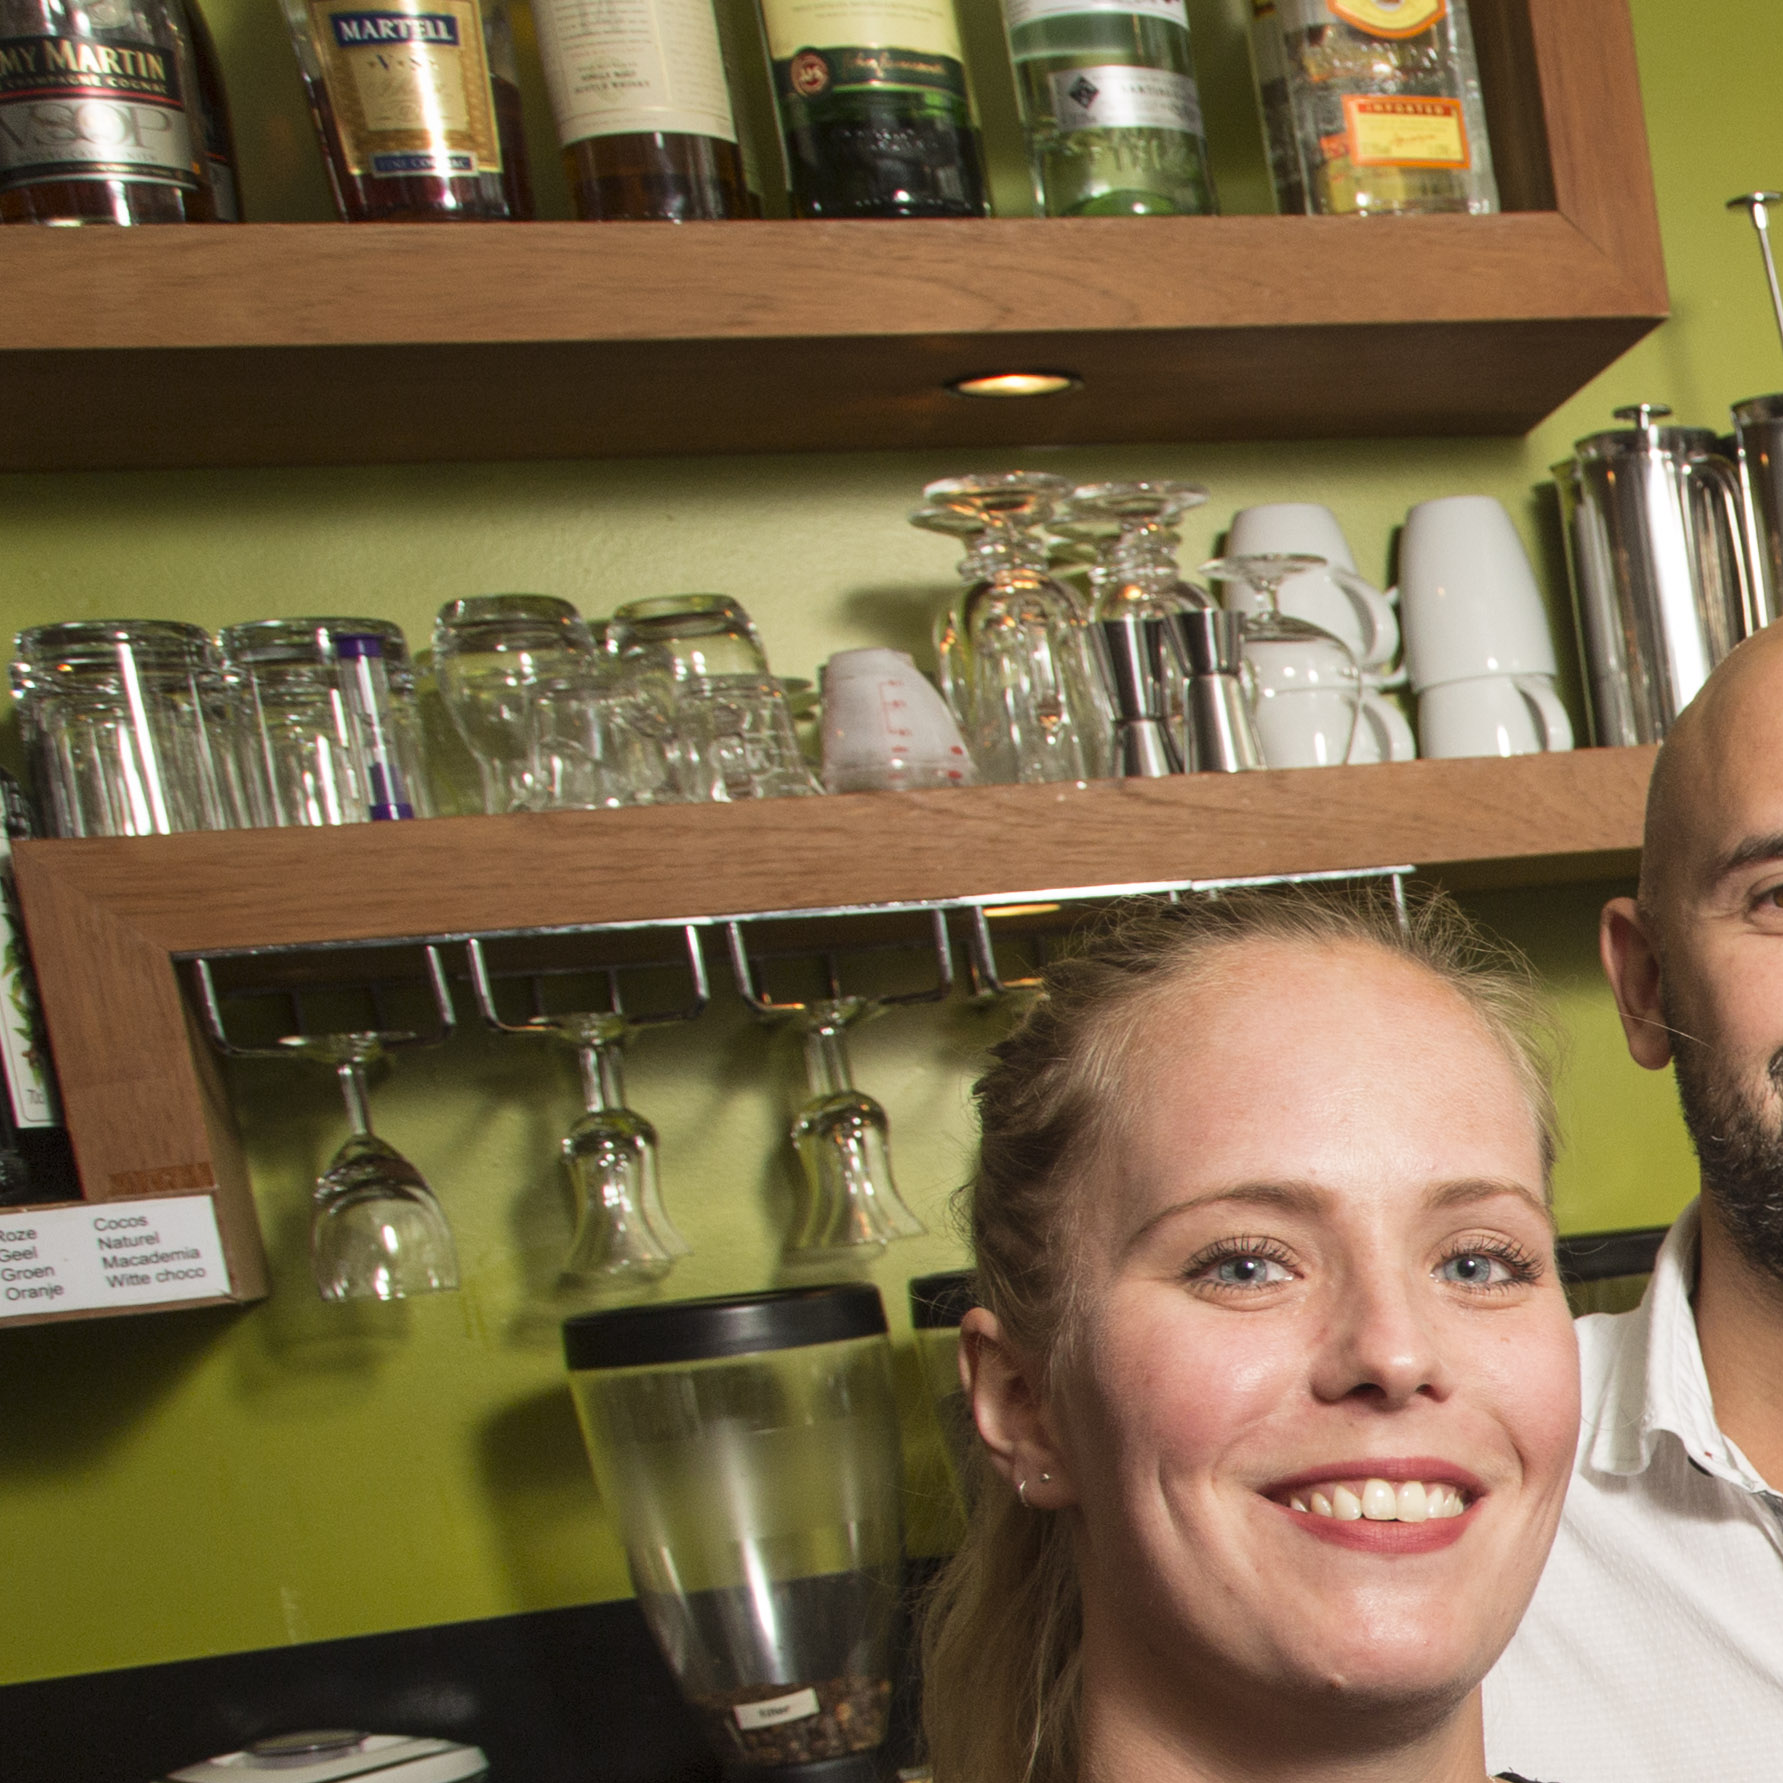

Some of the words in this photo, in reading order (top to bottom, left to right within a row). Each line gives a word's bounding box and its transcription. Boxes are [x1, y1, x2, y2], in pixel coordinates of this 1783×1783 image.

[338, 17, 454, 41] MARTELL
[43, 38, 167, 82] MARTIN
[93, 1215, 148, 1232] Cocos
[97, 1231, 161, 1250] Naturel
[0, 1246, 38, 1262] Geel
[102, 1247, 201, 1269] Macademia
[1, 1265, 55, 1282] Groen
[105, 1272, 152, 1289] Witte
[155, 1266, 207, 1283] choco
[5, 1283, 65, 1301] Oranje
